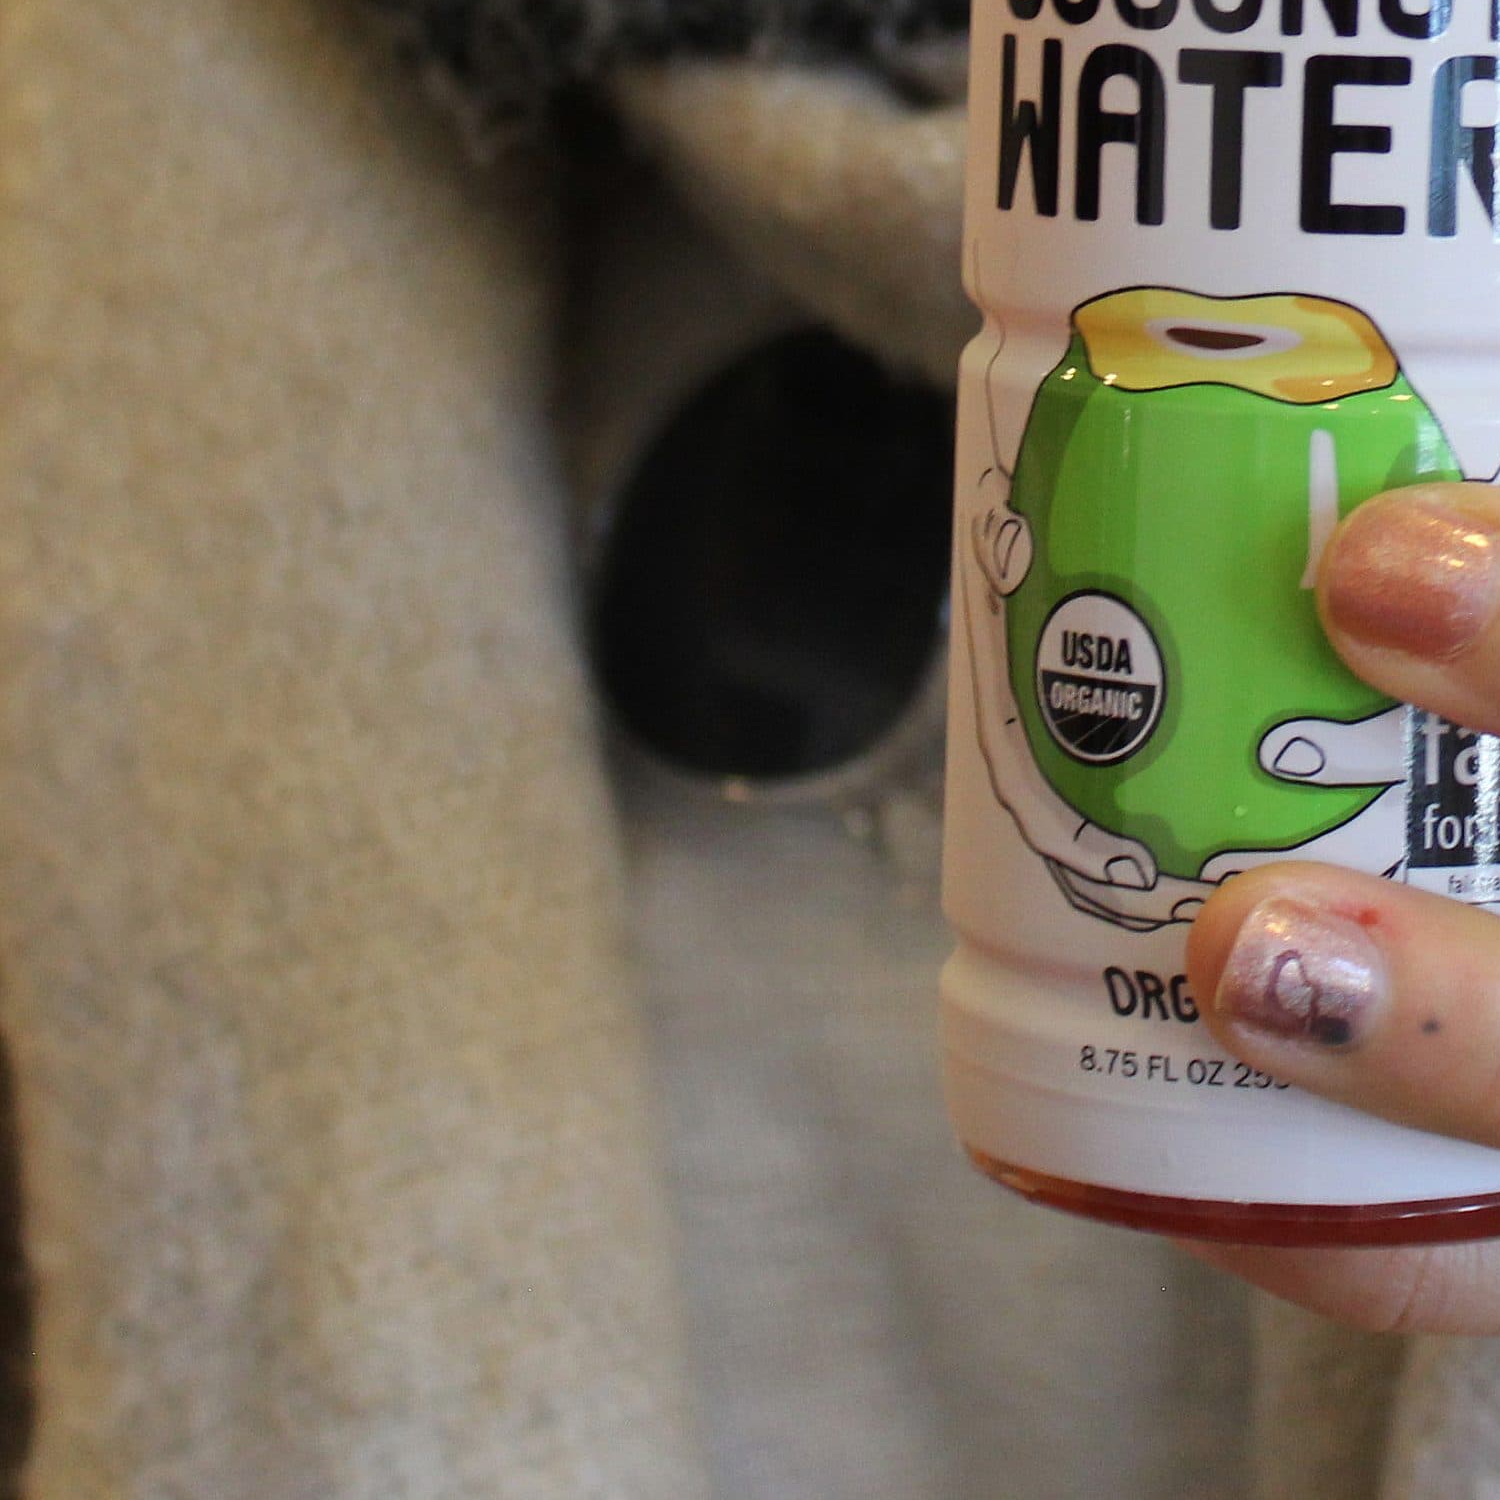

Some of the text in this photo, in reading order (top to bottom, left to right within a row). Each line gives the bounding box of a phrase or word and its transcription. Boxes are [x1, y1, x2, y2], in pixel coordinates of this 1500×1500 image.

[1062, 630, 1133, 675] USDA
[1050, 681, 1144, 721] ORGANIC
[1423, 803, 1485, 850] for
[1104, 966, 1200, 1023] ORG
[1080, 1045, 1139, 1078] 8.75
[1147, 1055, 1178, 1082] FL
[1187, 1059, 1224, 1086] OZ
